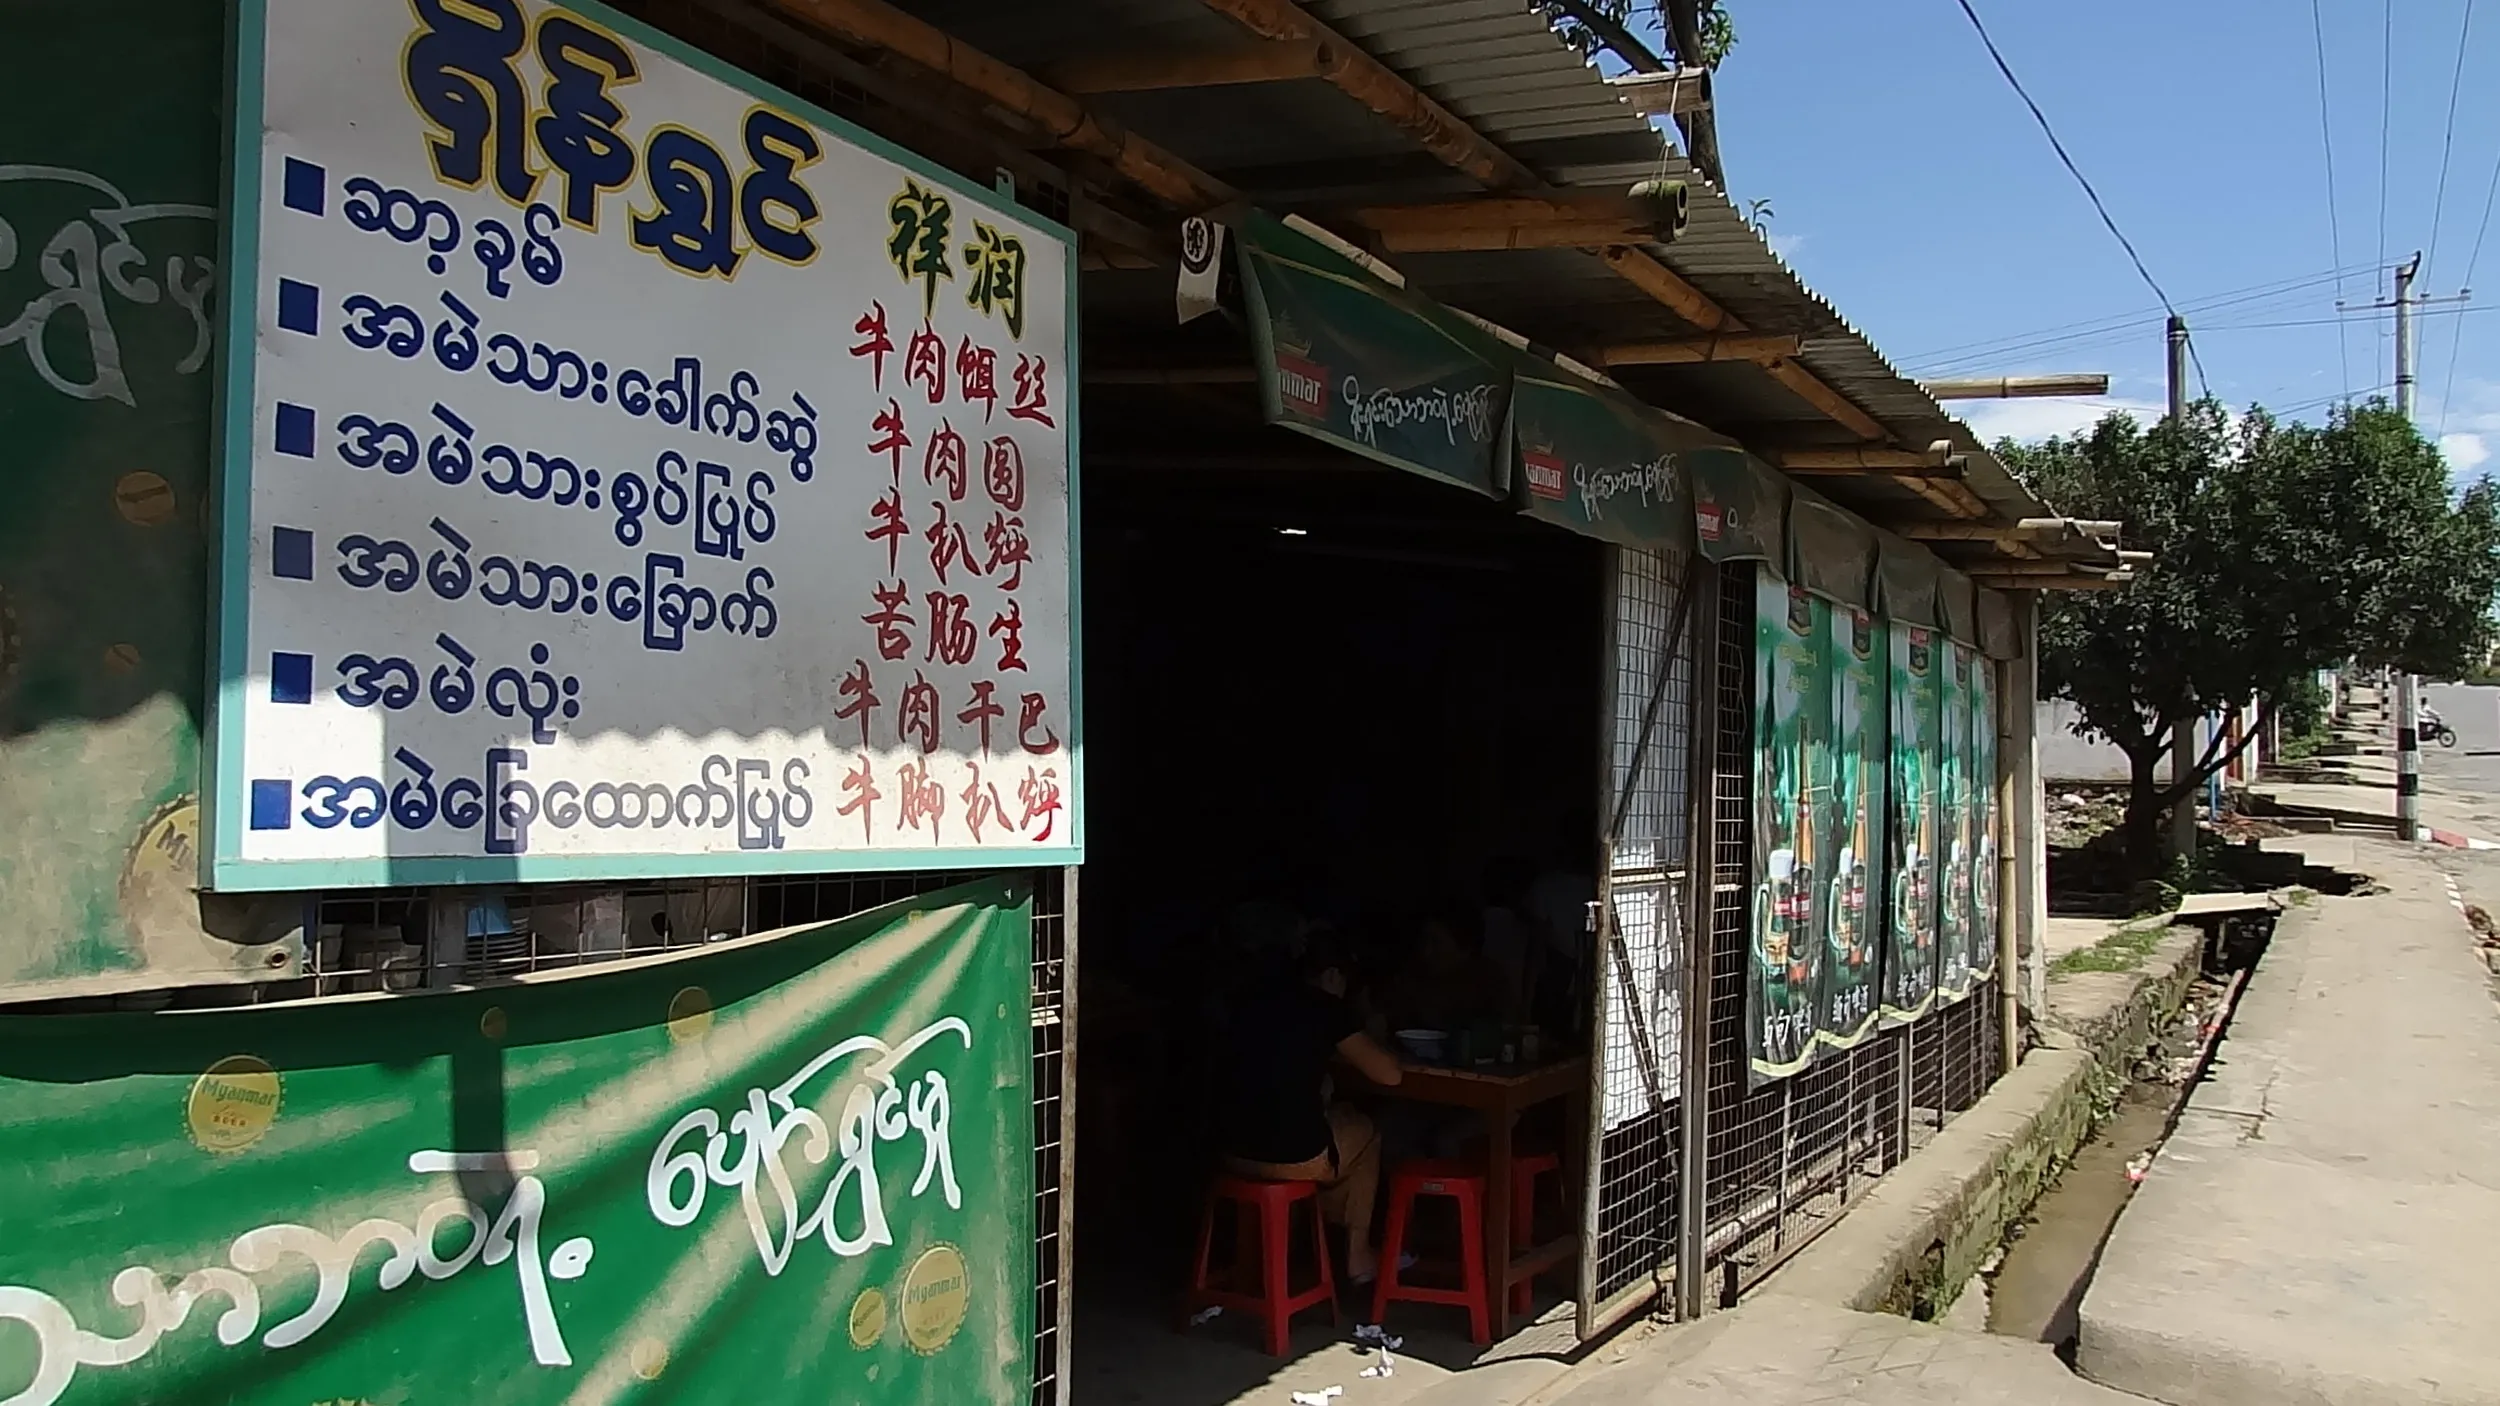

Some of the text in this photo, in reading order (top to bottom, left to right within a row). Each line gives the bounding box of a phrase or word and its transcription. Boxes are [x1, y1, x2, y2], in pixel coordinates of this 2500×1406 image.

[887, 177, 1029, 343] 祥润
[336, 516, 778, 651] အမဲသားခြောက်
[861, 577, 1030, 674] 苦肠生
[335, 632, 581, 745] အမဲလုံး
[834, 658, 1060, 763] 牛肉干巴
[201, 1075, 277, 1107] Myanmar
